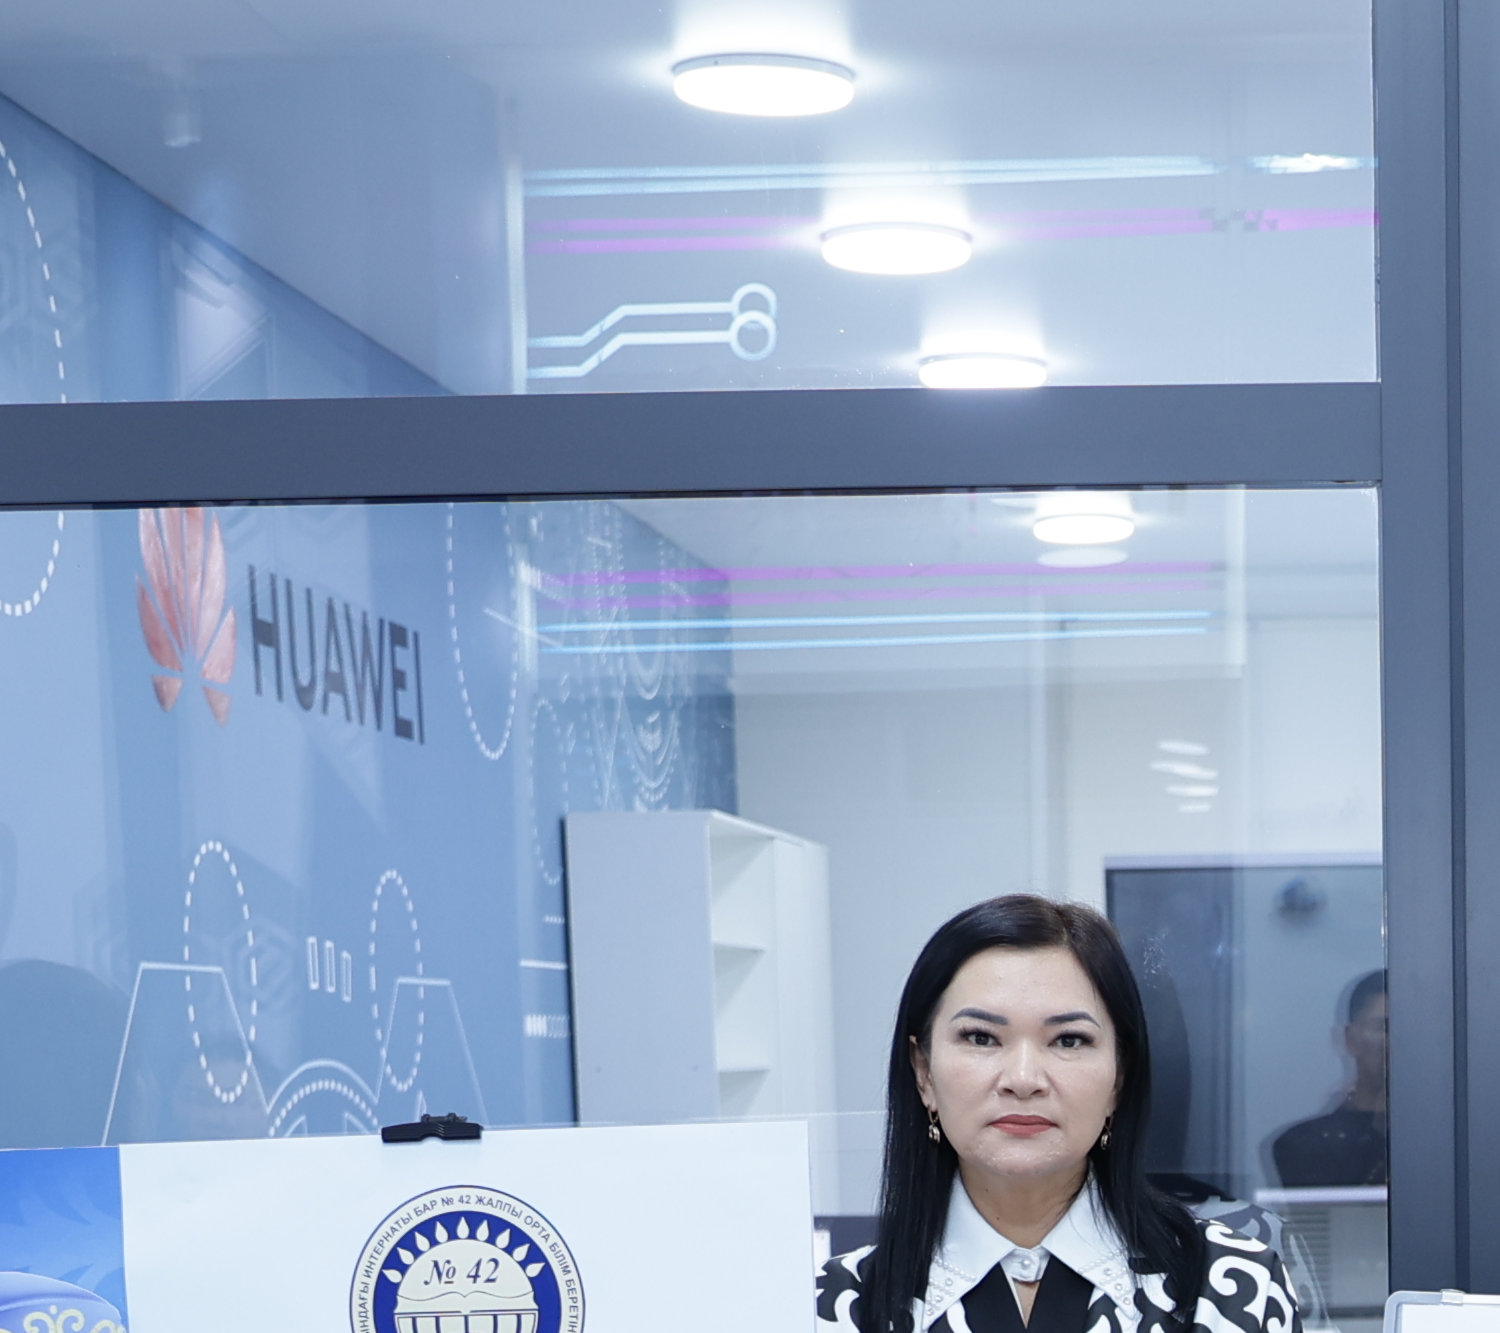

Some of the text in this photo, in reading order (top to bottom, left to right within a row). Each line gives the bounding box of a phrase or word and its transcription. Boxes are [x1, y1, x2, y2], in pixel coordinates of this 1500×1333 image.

[248, 564, 425, 745] HUAWEI
[367, 1214, 413, 1280] ИНТЕРНАТЫ
[414, 1199, 438, 1217] БАР
[458, 1195, 472, 1205] 42
[475, 1194, 523, 1219] ЖАЛПЫ
[524, 1215, 551, 1243] ОРТА
[549, 1241, 573, 1276] БІЛІМ
[565, 1278, 579, 1333] БЕРЕТІН
[423, 1257, 500, 1285] № 42
